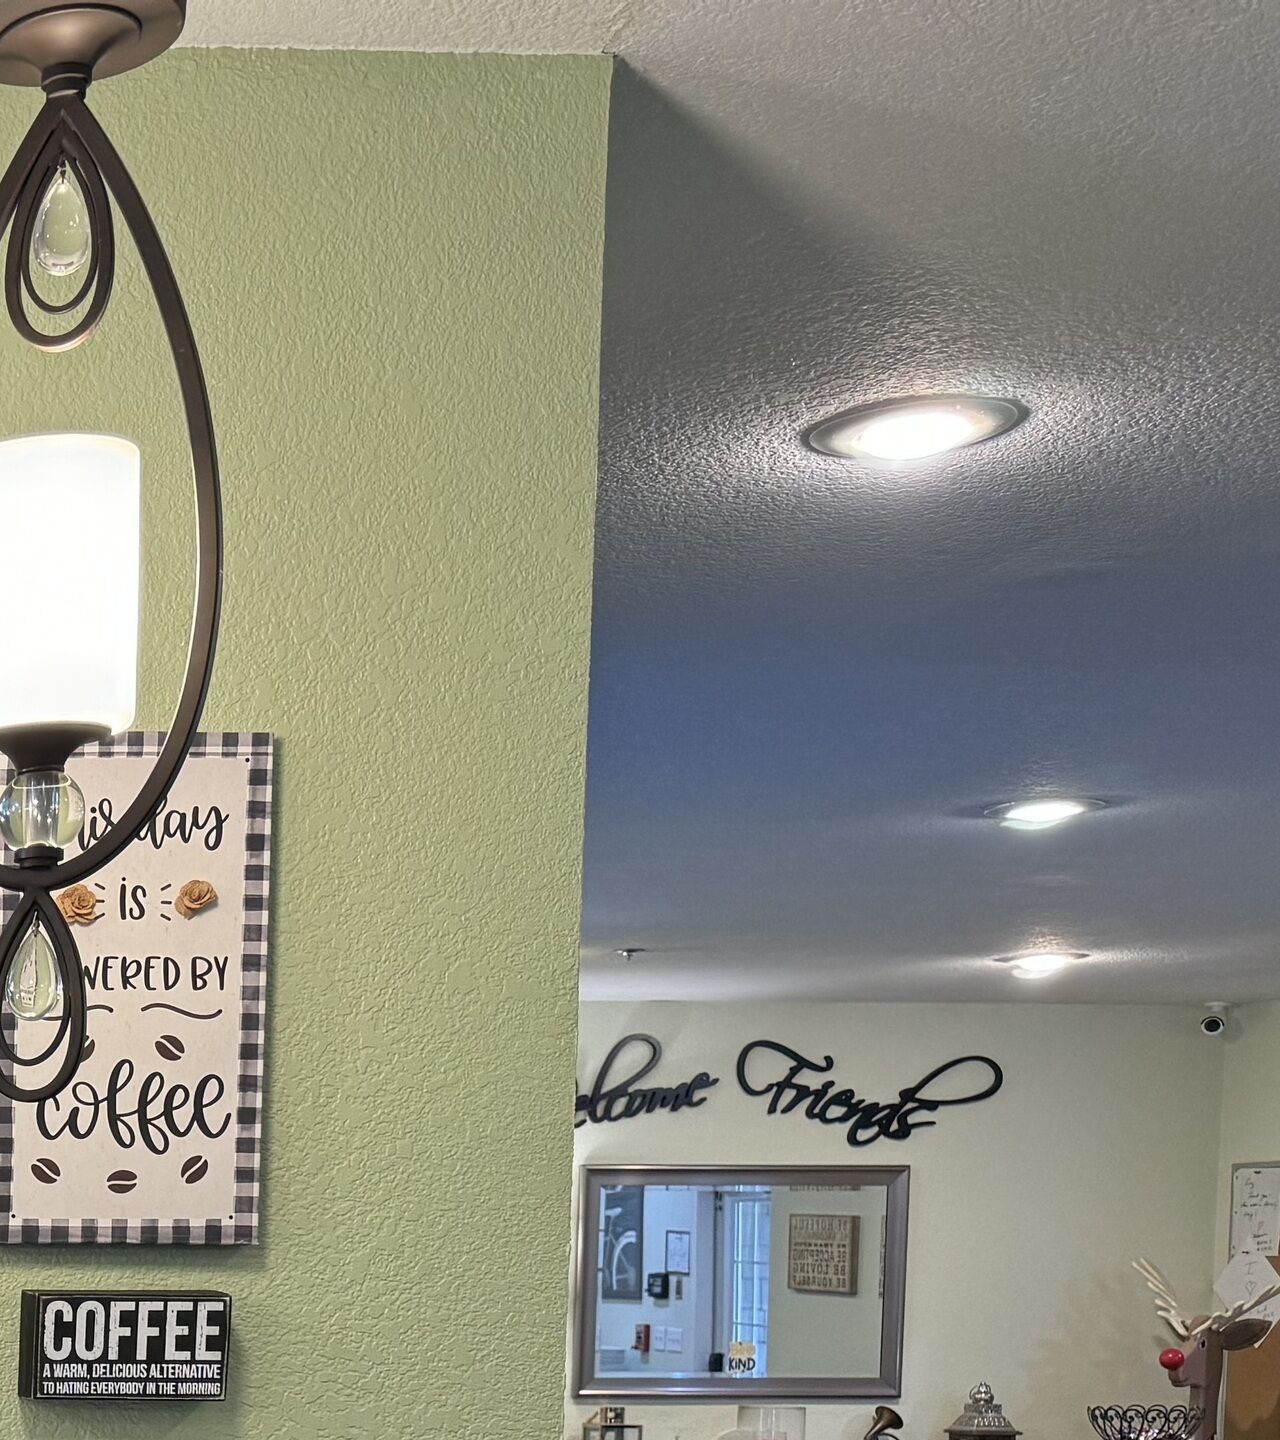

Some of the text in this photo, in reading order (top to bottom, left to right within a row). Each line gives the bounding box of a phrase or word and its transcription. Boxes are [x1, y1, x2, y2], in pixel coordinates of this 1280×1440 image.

[119, 876, 147, 921] is
[83, 955, 229, 991] WERED BY
[574, 1033, 1004, 1148] elcome Friends
[43, 1300, 225, 1361] COFFEE
[42, 1363, 221, 1379] A WARM, DELICIOUS ALTERNATIVE
[728, 1356, 756, 1371] KIND
[42, 1381, 221, 1395] TO HATING EVERYBODY IN THE MORNING
